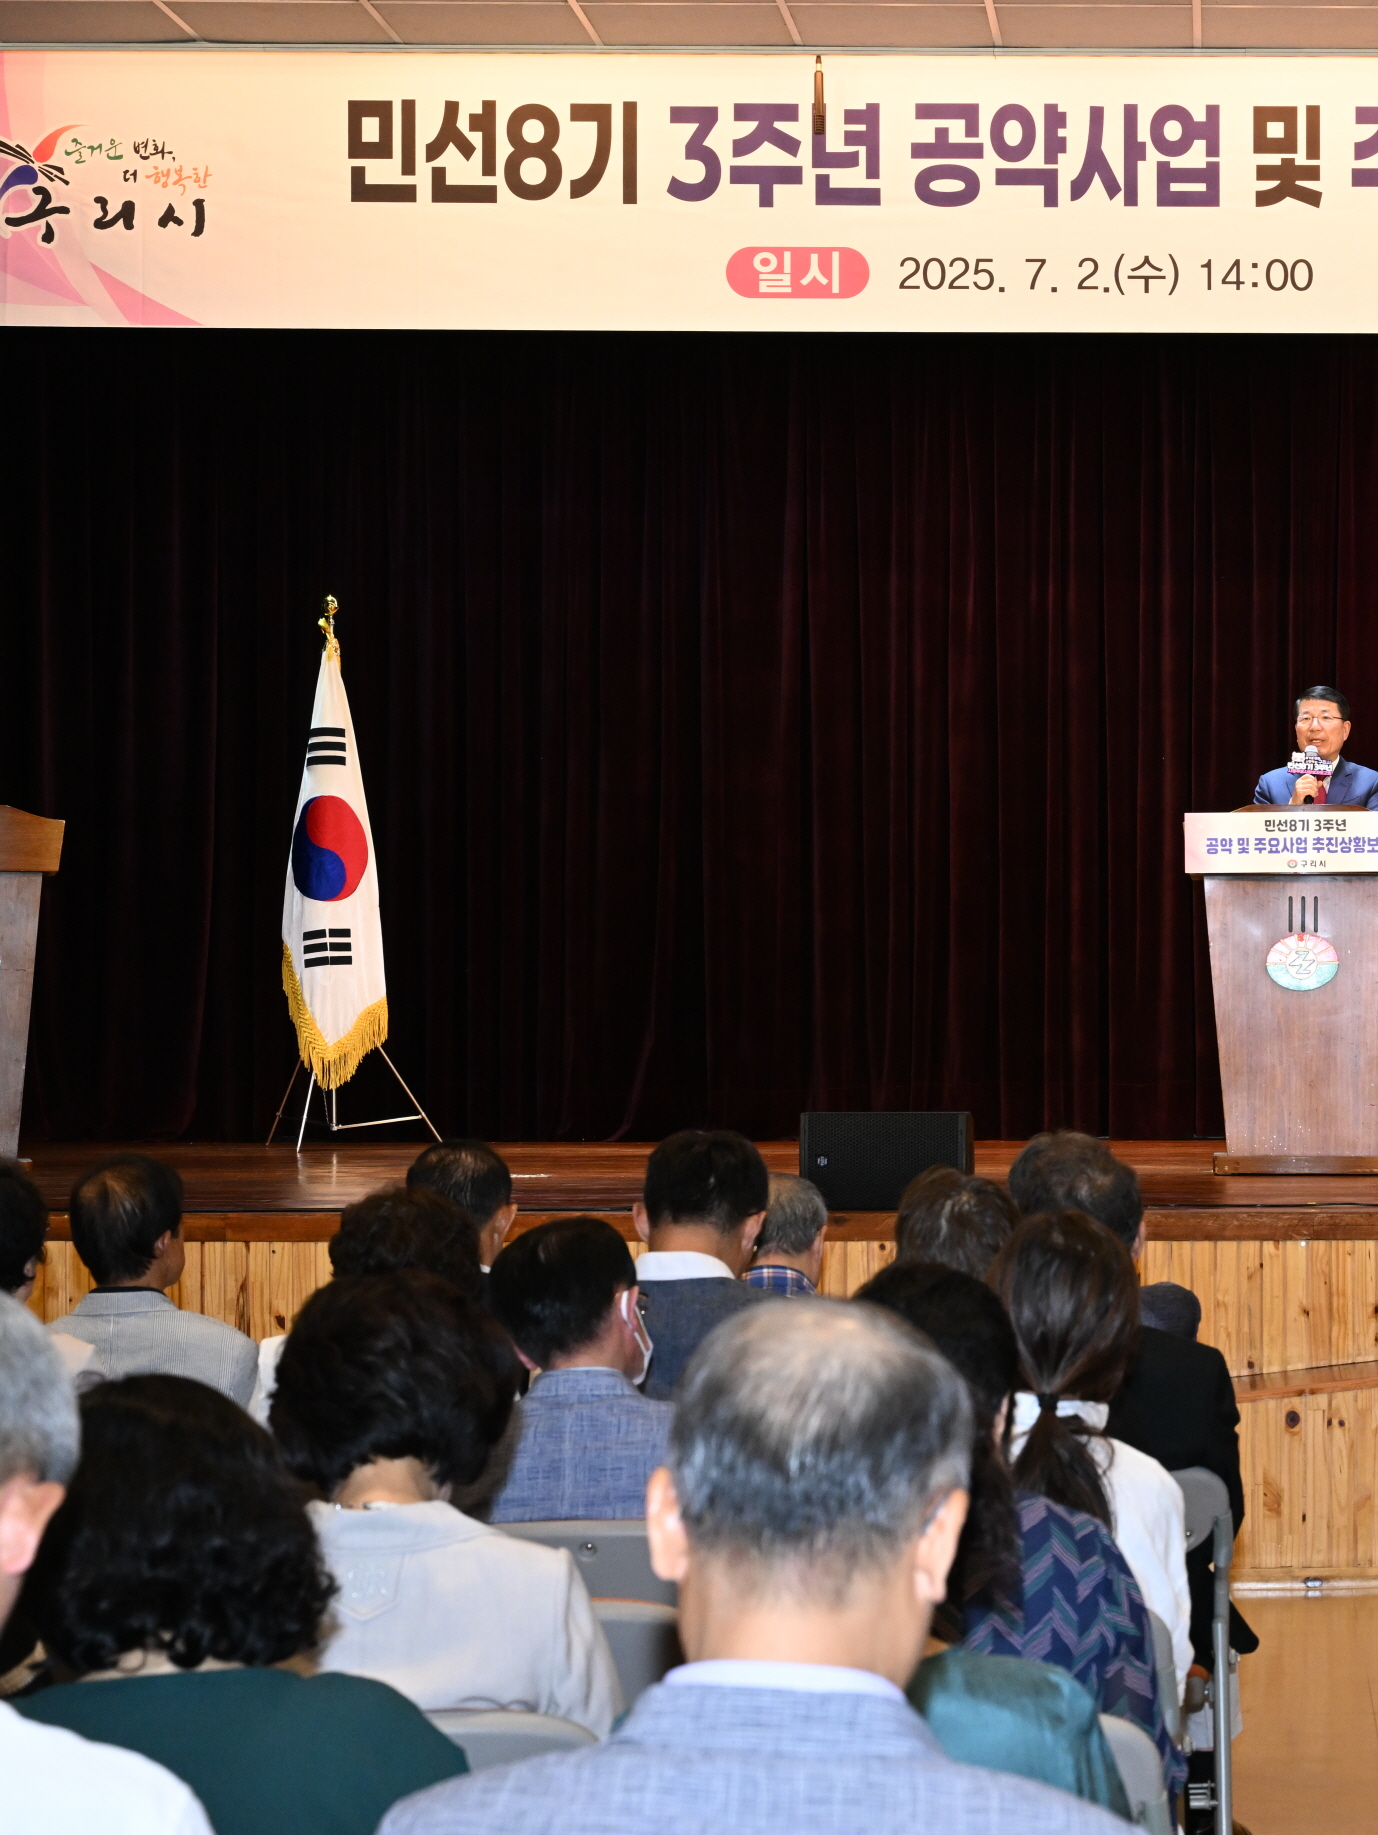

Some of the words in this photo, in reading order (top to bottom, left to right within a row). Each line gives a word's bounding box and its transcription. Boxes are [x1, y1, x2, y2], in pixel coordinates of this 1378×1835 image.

[64, 137, 124, 164] 즐거운
[133, 138, 176, 163] 변화,
[348, 99, 637, 205] 민선8기
[667, 102, 881, 208] 3주년
[911, 103, 1220, 208] 공약사업
[1253, 105, 1323, 209] 및
[122, 169, 138, 183] 더
[145, 165, 213, 196] 행복한
[4, 186, 206, 245] 구리시
[752, 251, 841, 294] 일시
[898, 256, 1006, 293] 2025.
[1026, 258, 1058, 293] 7.
[1078, 254, 1180, 296] 2.(수)
[1201, 258, 1314, 292] 14:00
[1264, 819, 1310, 832] 민선8기
[1314, 819, 1347, 832] 3주년
[1206, 838, 1233, 855] 공약
[1237, 838, 1250, 854] 및
[1254, 837, 1308, 854] 주요사업
[1301, 859, 1327, 868] 구리시
